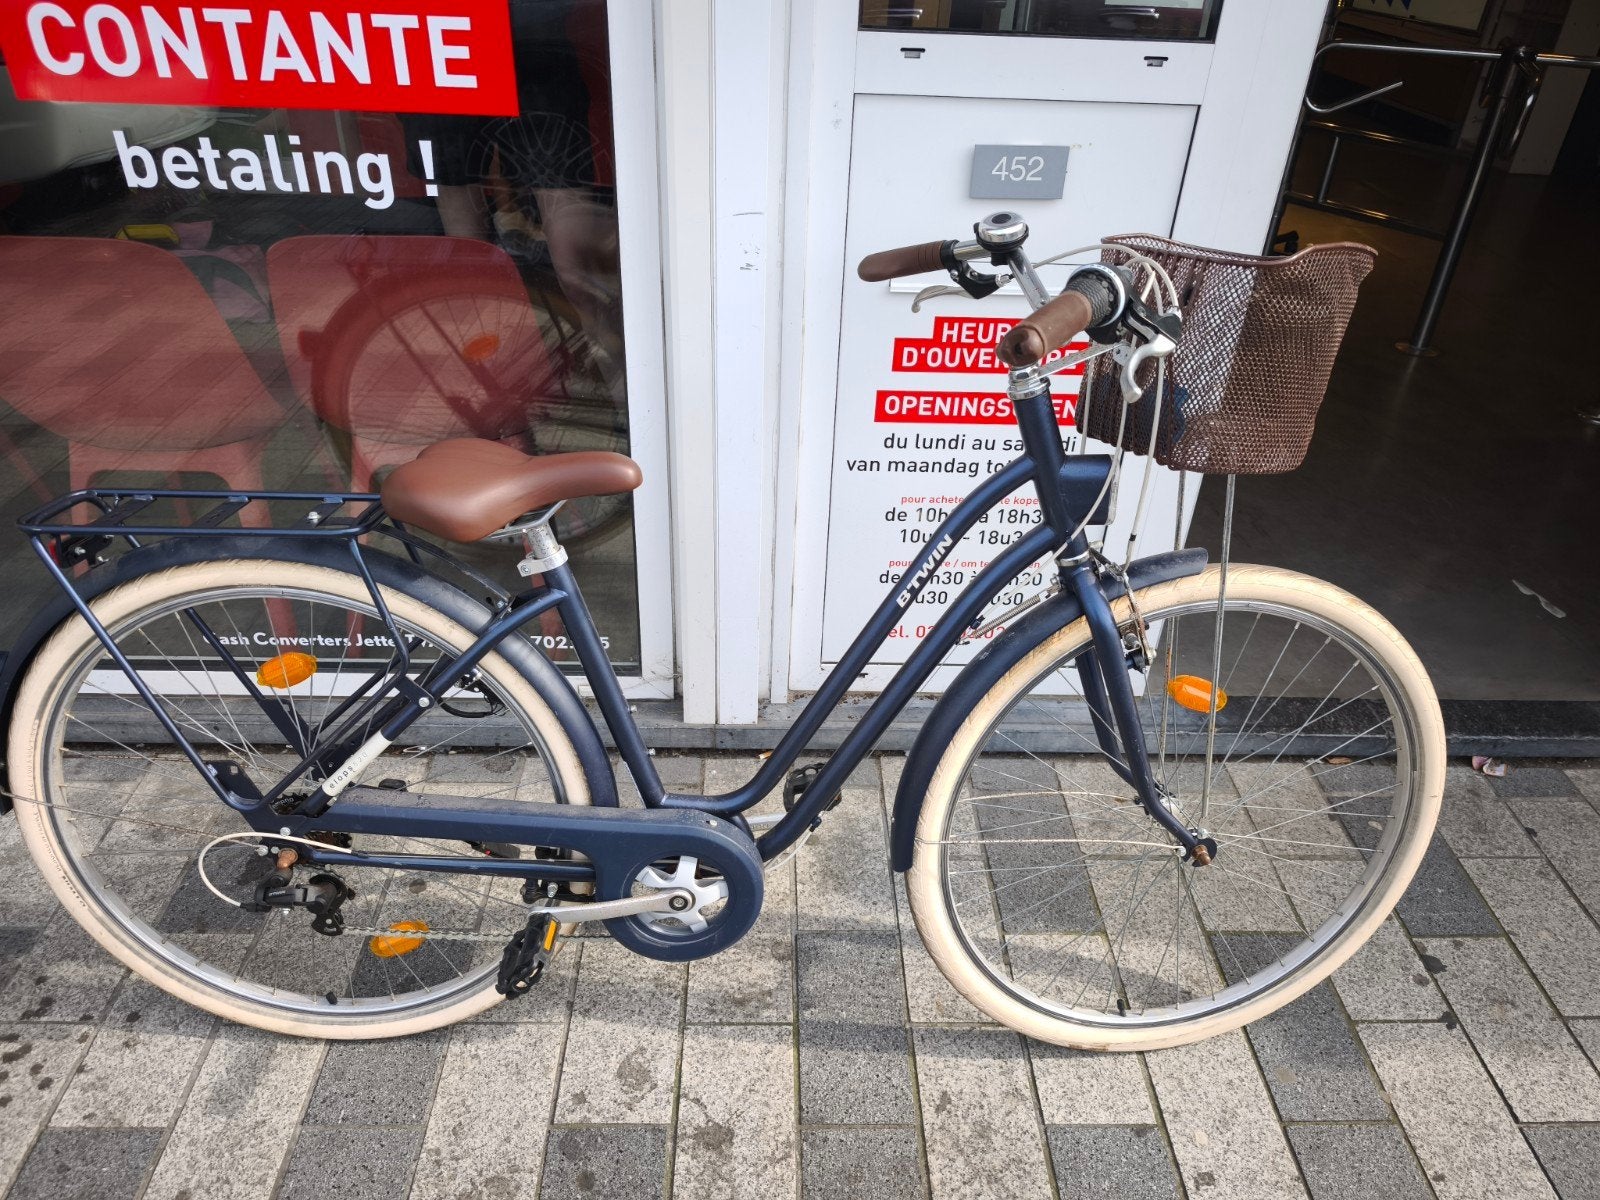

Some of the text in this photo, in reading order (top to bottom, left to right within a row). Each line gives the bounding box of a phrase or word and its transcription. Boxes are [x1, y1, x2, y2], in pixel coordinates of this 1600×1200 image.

[27, 2, 478, 89] CONTANTE
[112, 130, 439, 210] betaling !
[991, 155, 1045, 181] 452
[884, 433, 908, 449] du
[915, 433, 966, 450] lundi
[972, 438, 996, 451] au
[847, 459, 880, 472] van
[888, 458, 979, 478] maandag
[901, 496, 926, 506] pour
[885, 507, 907, 522] de
[879, 570, 900, 584] de
[253, 631, 351, 647] Converters
